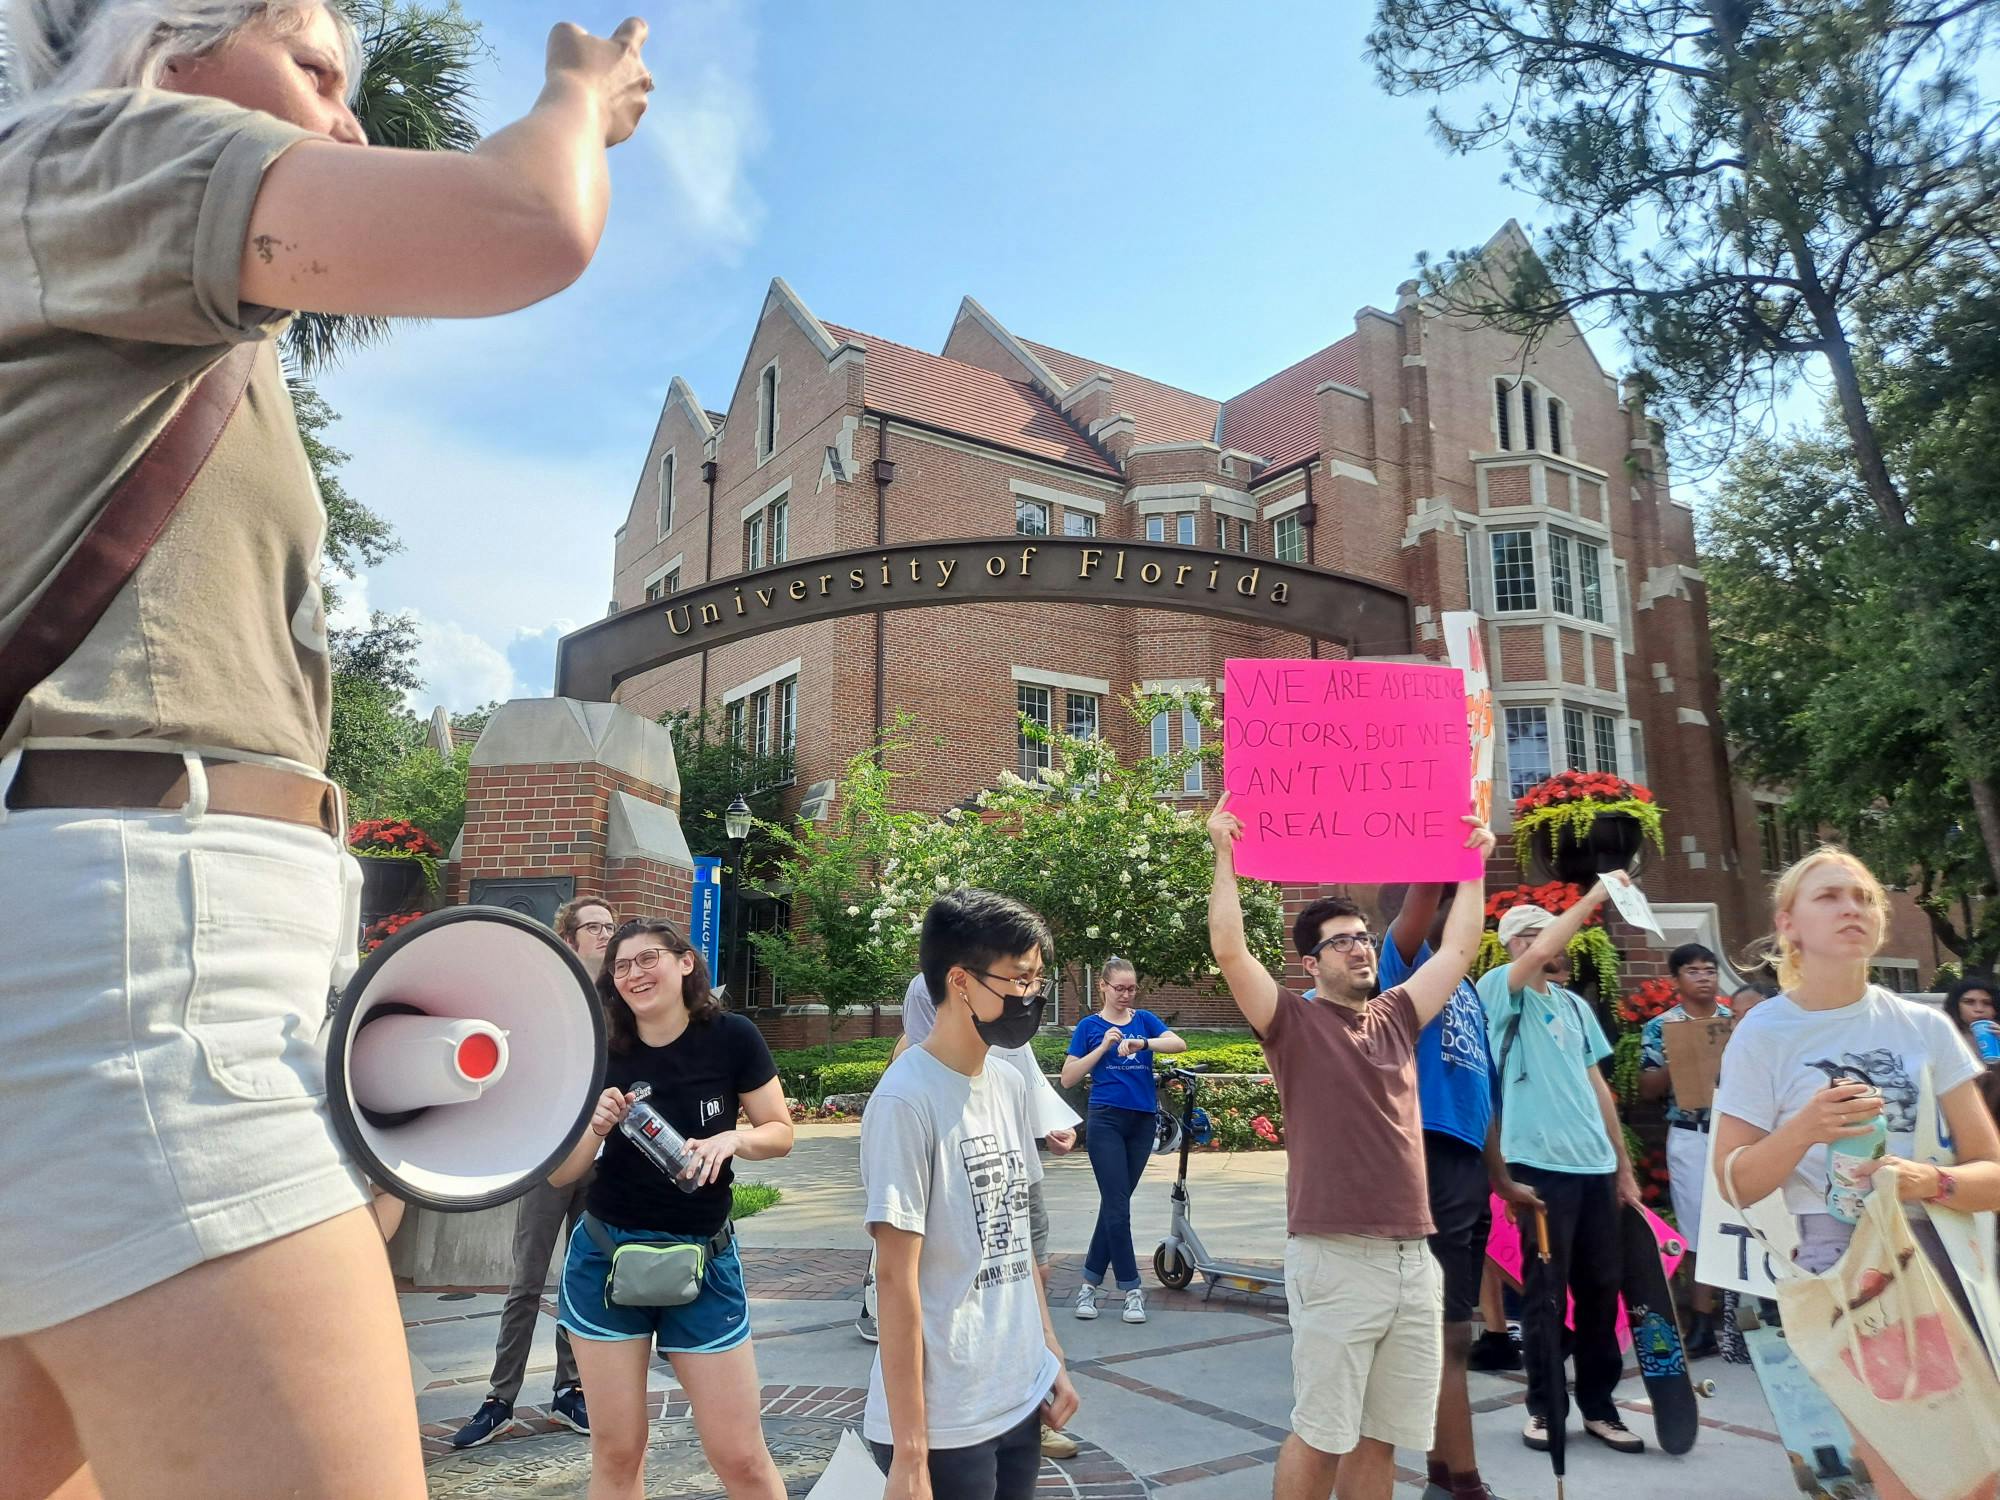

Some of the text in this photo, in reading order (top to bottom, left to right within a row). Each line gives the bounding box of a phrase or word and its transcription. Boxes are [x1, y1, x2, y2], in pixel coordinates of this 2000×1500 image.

[664, 547, 1290, 635] University of Florida
[1227, 667, 1464, 708] WE ARE ASPIRING
[1226, 717, 1462, 752] DOCTORS, BUT WE
[1226, 759, 1438, 795] CAN'T VISIT
[1259, 811, 1444, 842] REAL ONE
[706, 1100, 720, 1116] OR
